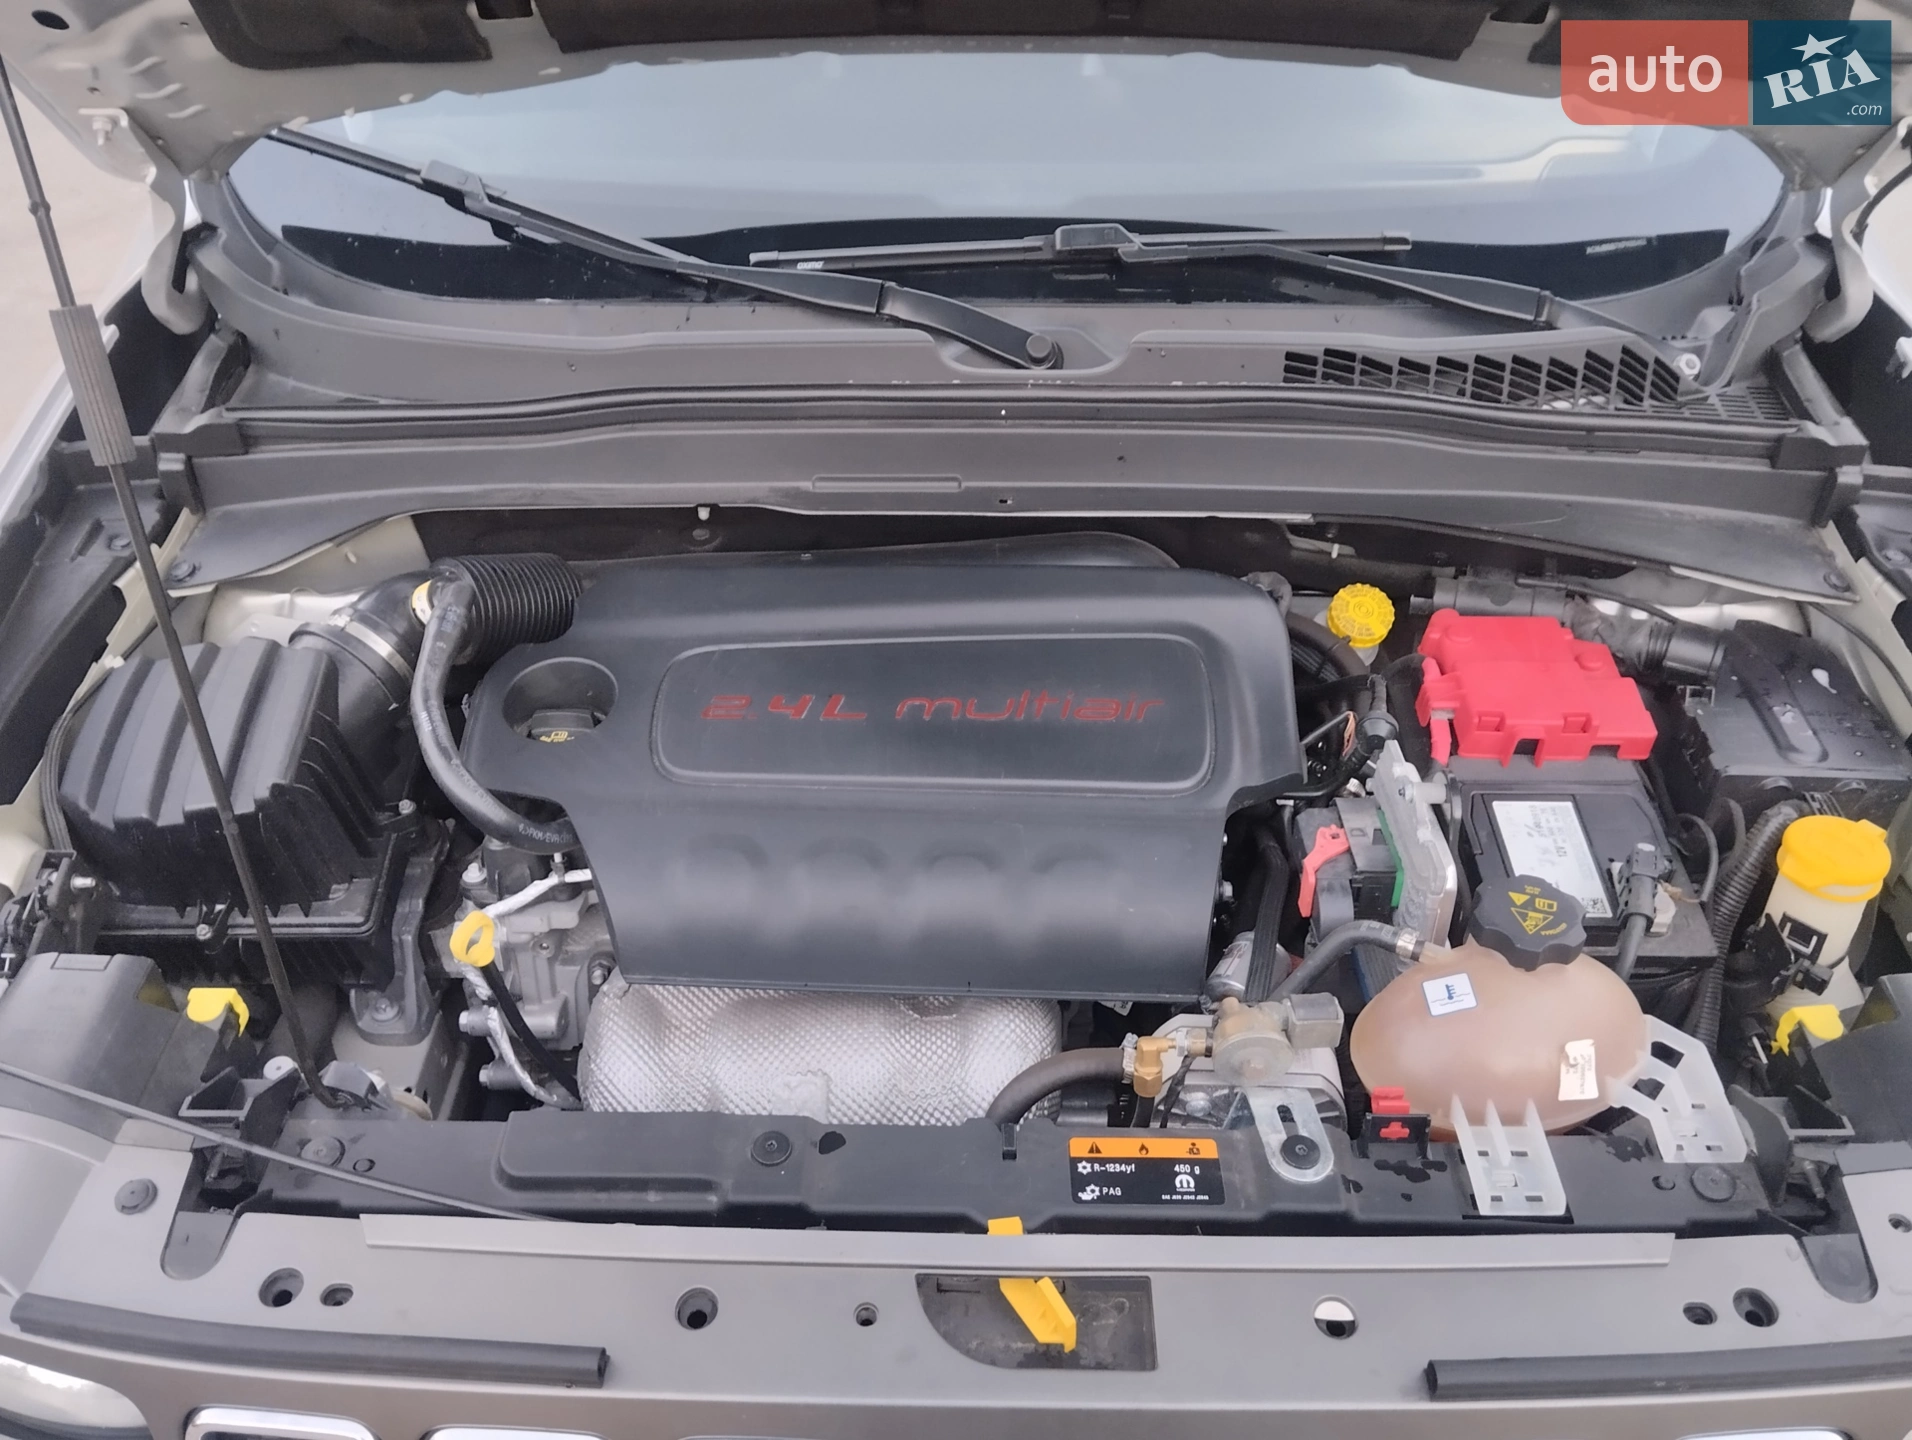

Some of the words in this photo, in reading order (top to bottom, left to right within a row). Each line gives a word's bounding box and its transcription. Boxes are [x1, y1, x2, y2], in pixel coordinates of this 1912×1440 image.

[700, 693, 868, 721] 2.4L
[895, 689, 1166, 722] multiair
[1174, 1163, 1191, 1173] 450
[1103, 1187, 1122, 1196] PAG
